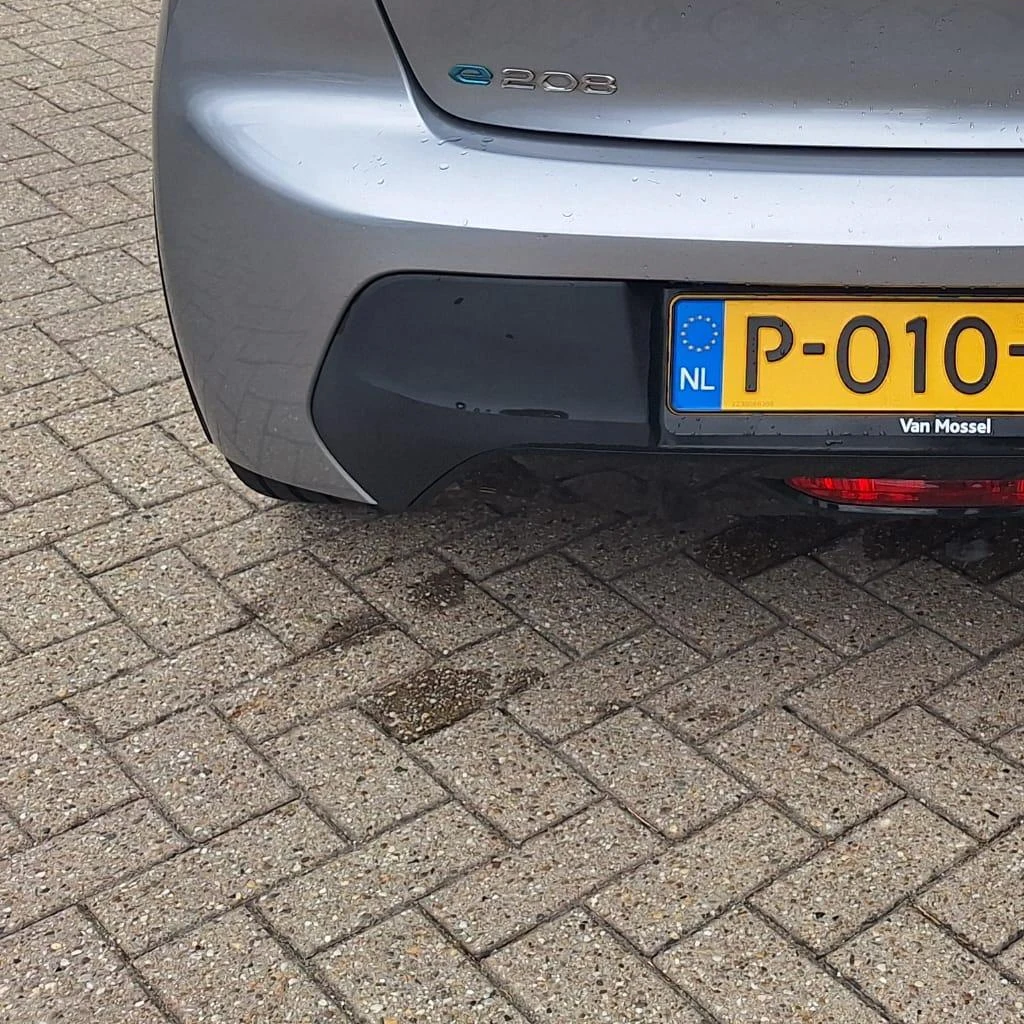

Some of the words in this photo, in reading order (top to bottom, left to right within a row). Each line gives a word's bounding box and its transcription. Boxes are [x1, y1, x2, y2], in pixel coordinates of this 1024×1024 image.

[680, 367, 716, 391] NL
[899, 418, 930, 433] Van
[934, 418, 991, 434] Mossel
